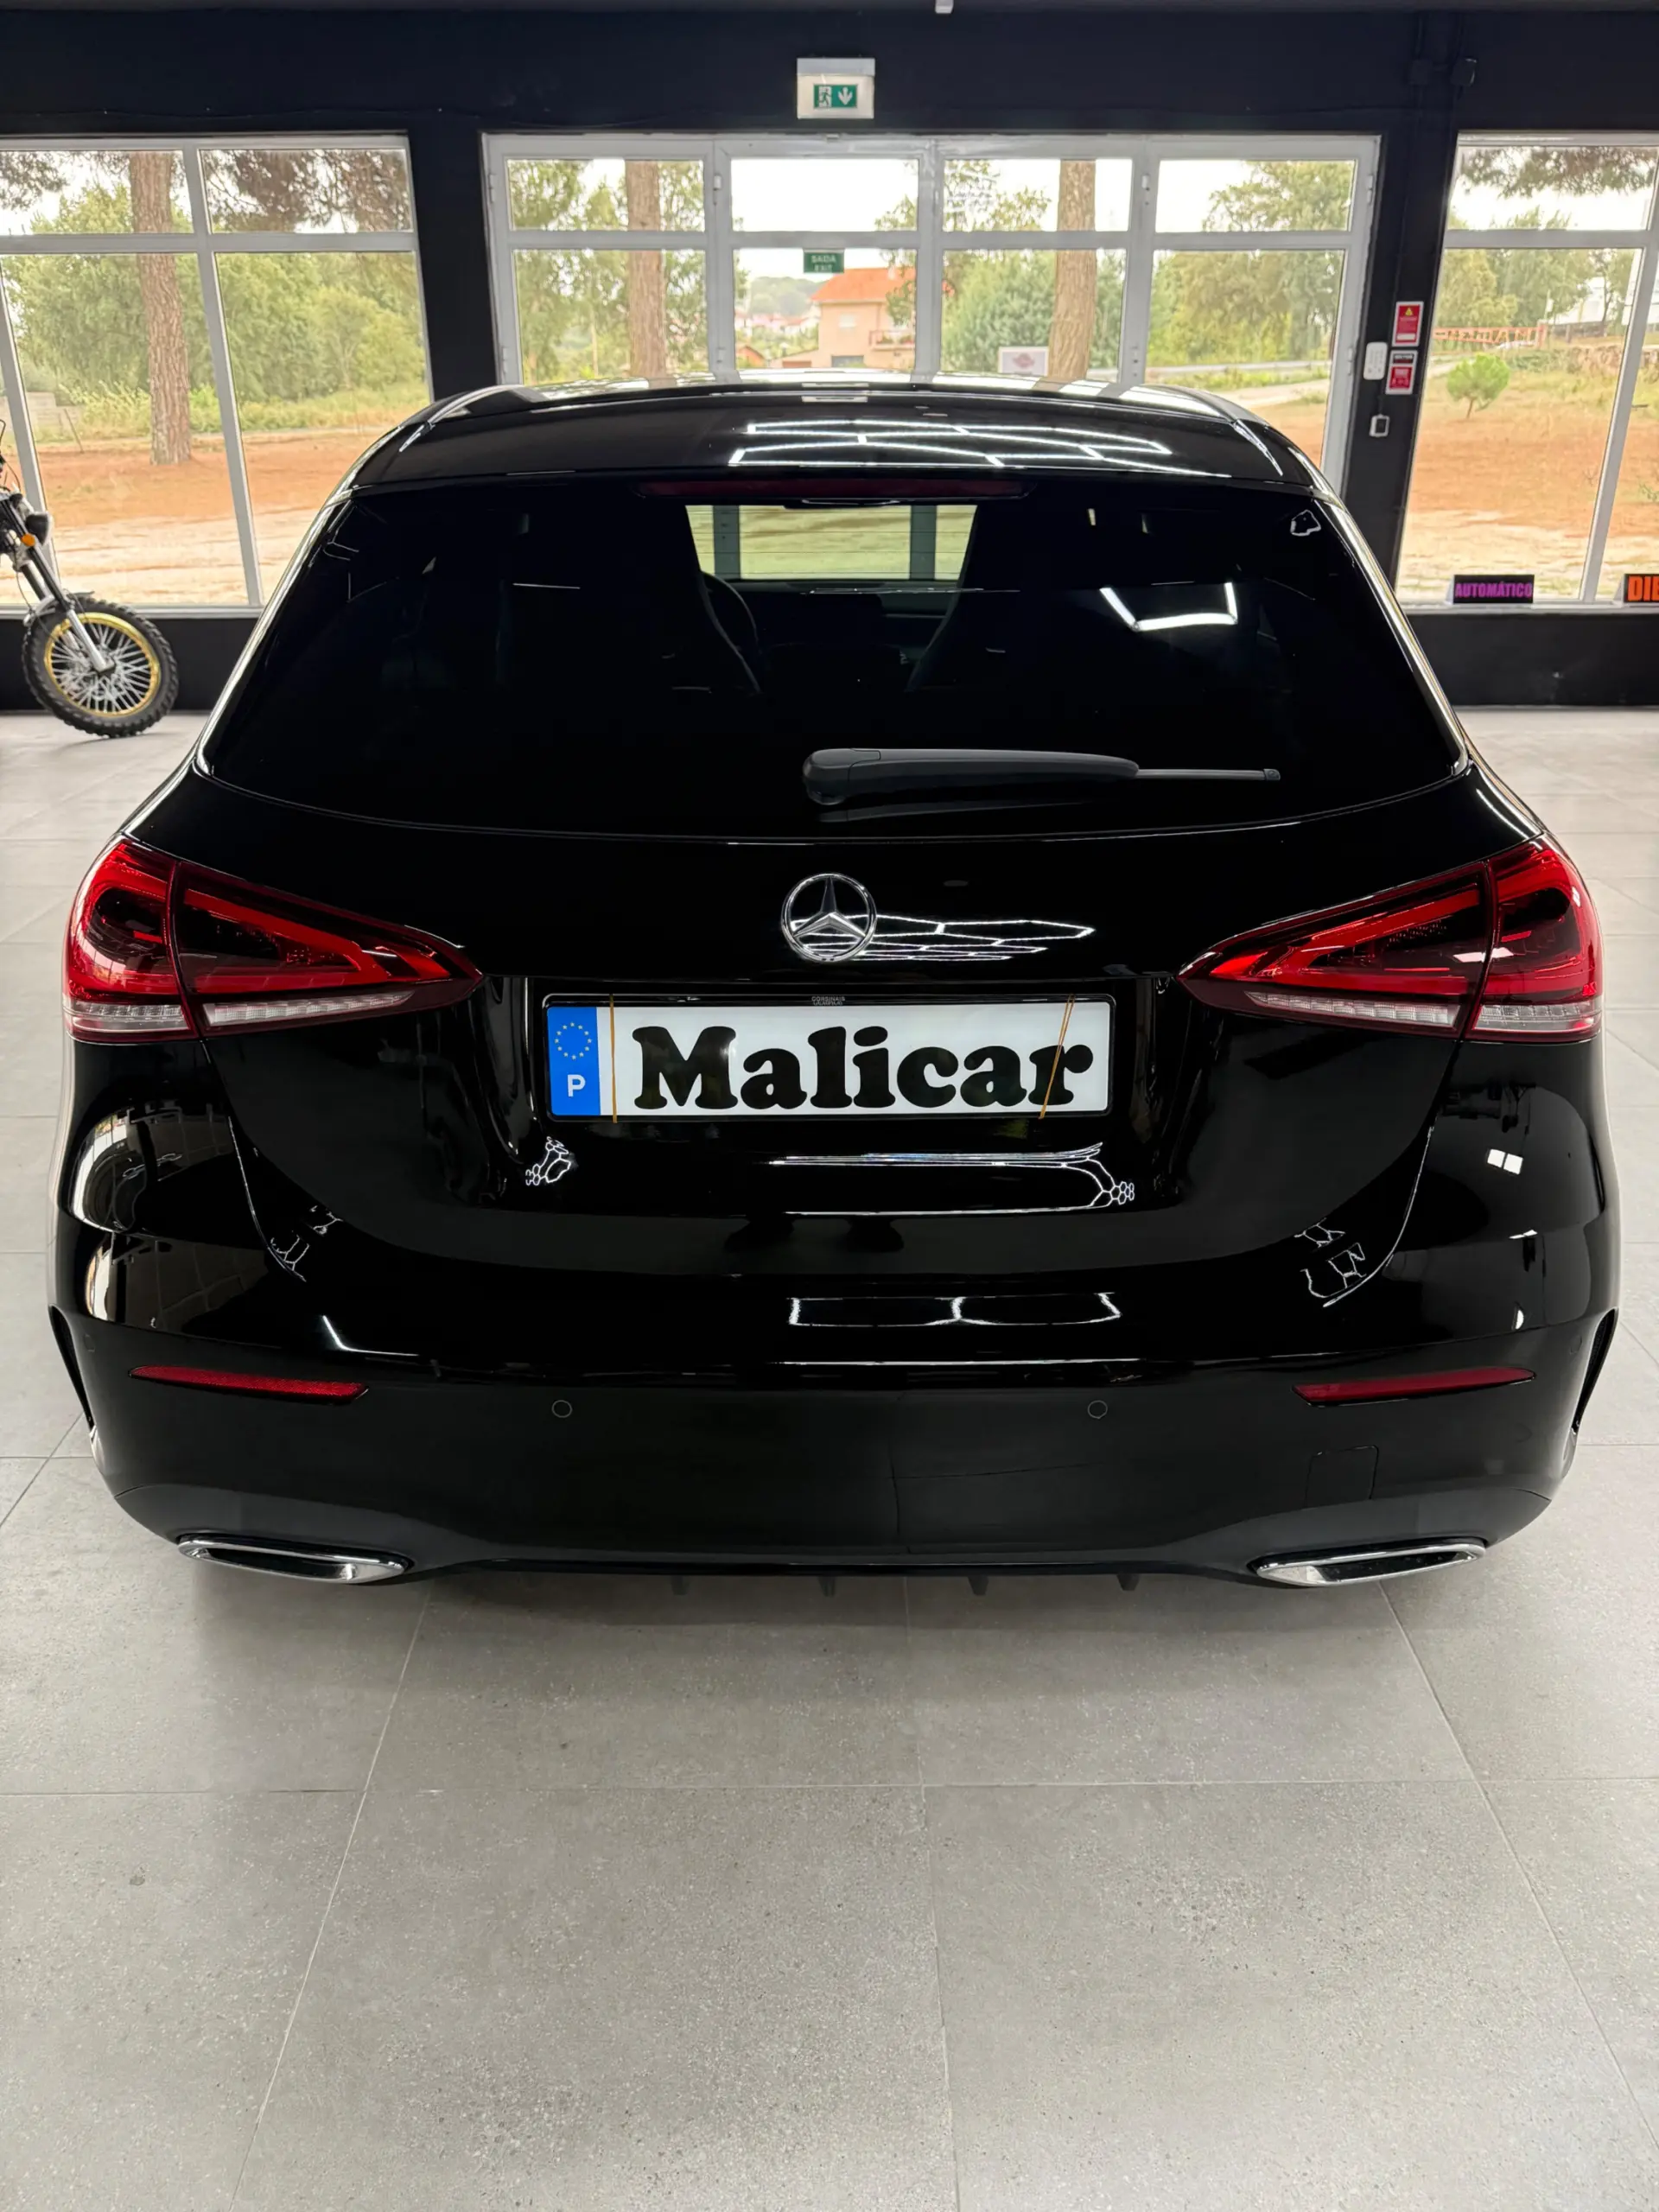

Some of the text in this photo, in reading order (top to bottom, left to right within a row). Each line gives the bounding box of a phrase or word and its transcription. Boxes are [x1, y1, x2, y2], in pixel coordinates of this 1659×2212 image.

[1455, 581, 1532, 598] AUTOMÁTICO
[632, 1026, 1094, 1110] Malicar
[567, 1074, 586, 1097] P
